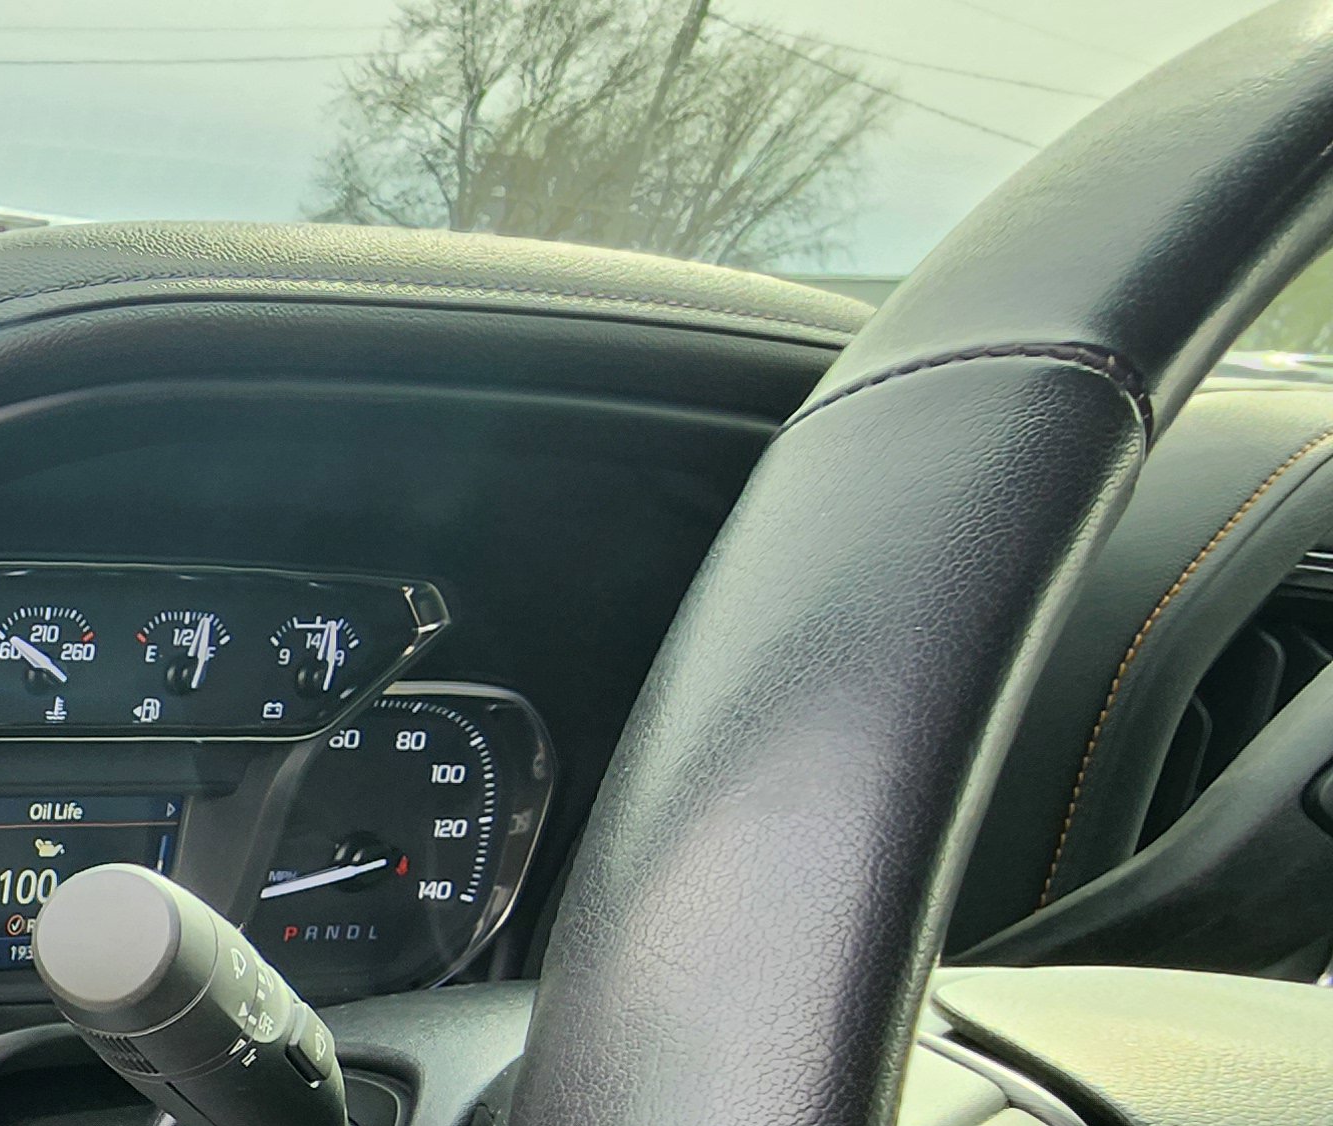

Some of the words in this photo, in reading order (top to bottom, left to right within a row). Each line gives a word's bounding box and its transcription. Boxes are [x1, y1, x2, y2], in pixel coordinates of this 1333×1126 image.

[30, 624, 59, 643] 210
[60, 643, 95, 661] 260
[145, 645, 157, 662] E
[278, 649, 290, 665] 9
[396, 731, 426, 750] 80
[431, 764, 465, 784] 100
[29, 803, 52, 820] Oil
[54, 802, 83, 820] Life
[434, 819, 468, 838] 120
[0, 868, 58, 905] 100
[418, 881, 452, 900] 140
[259, 1012, 274, 1035] OFF
